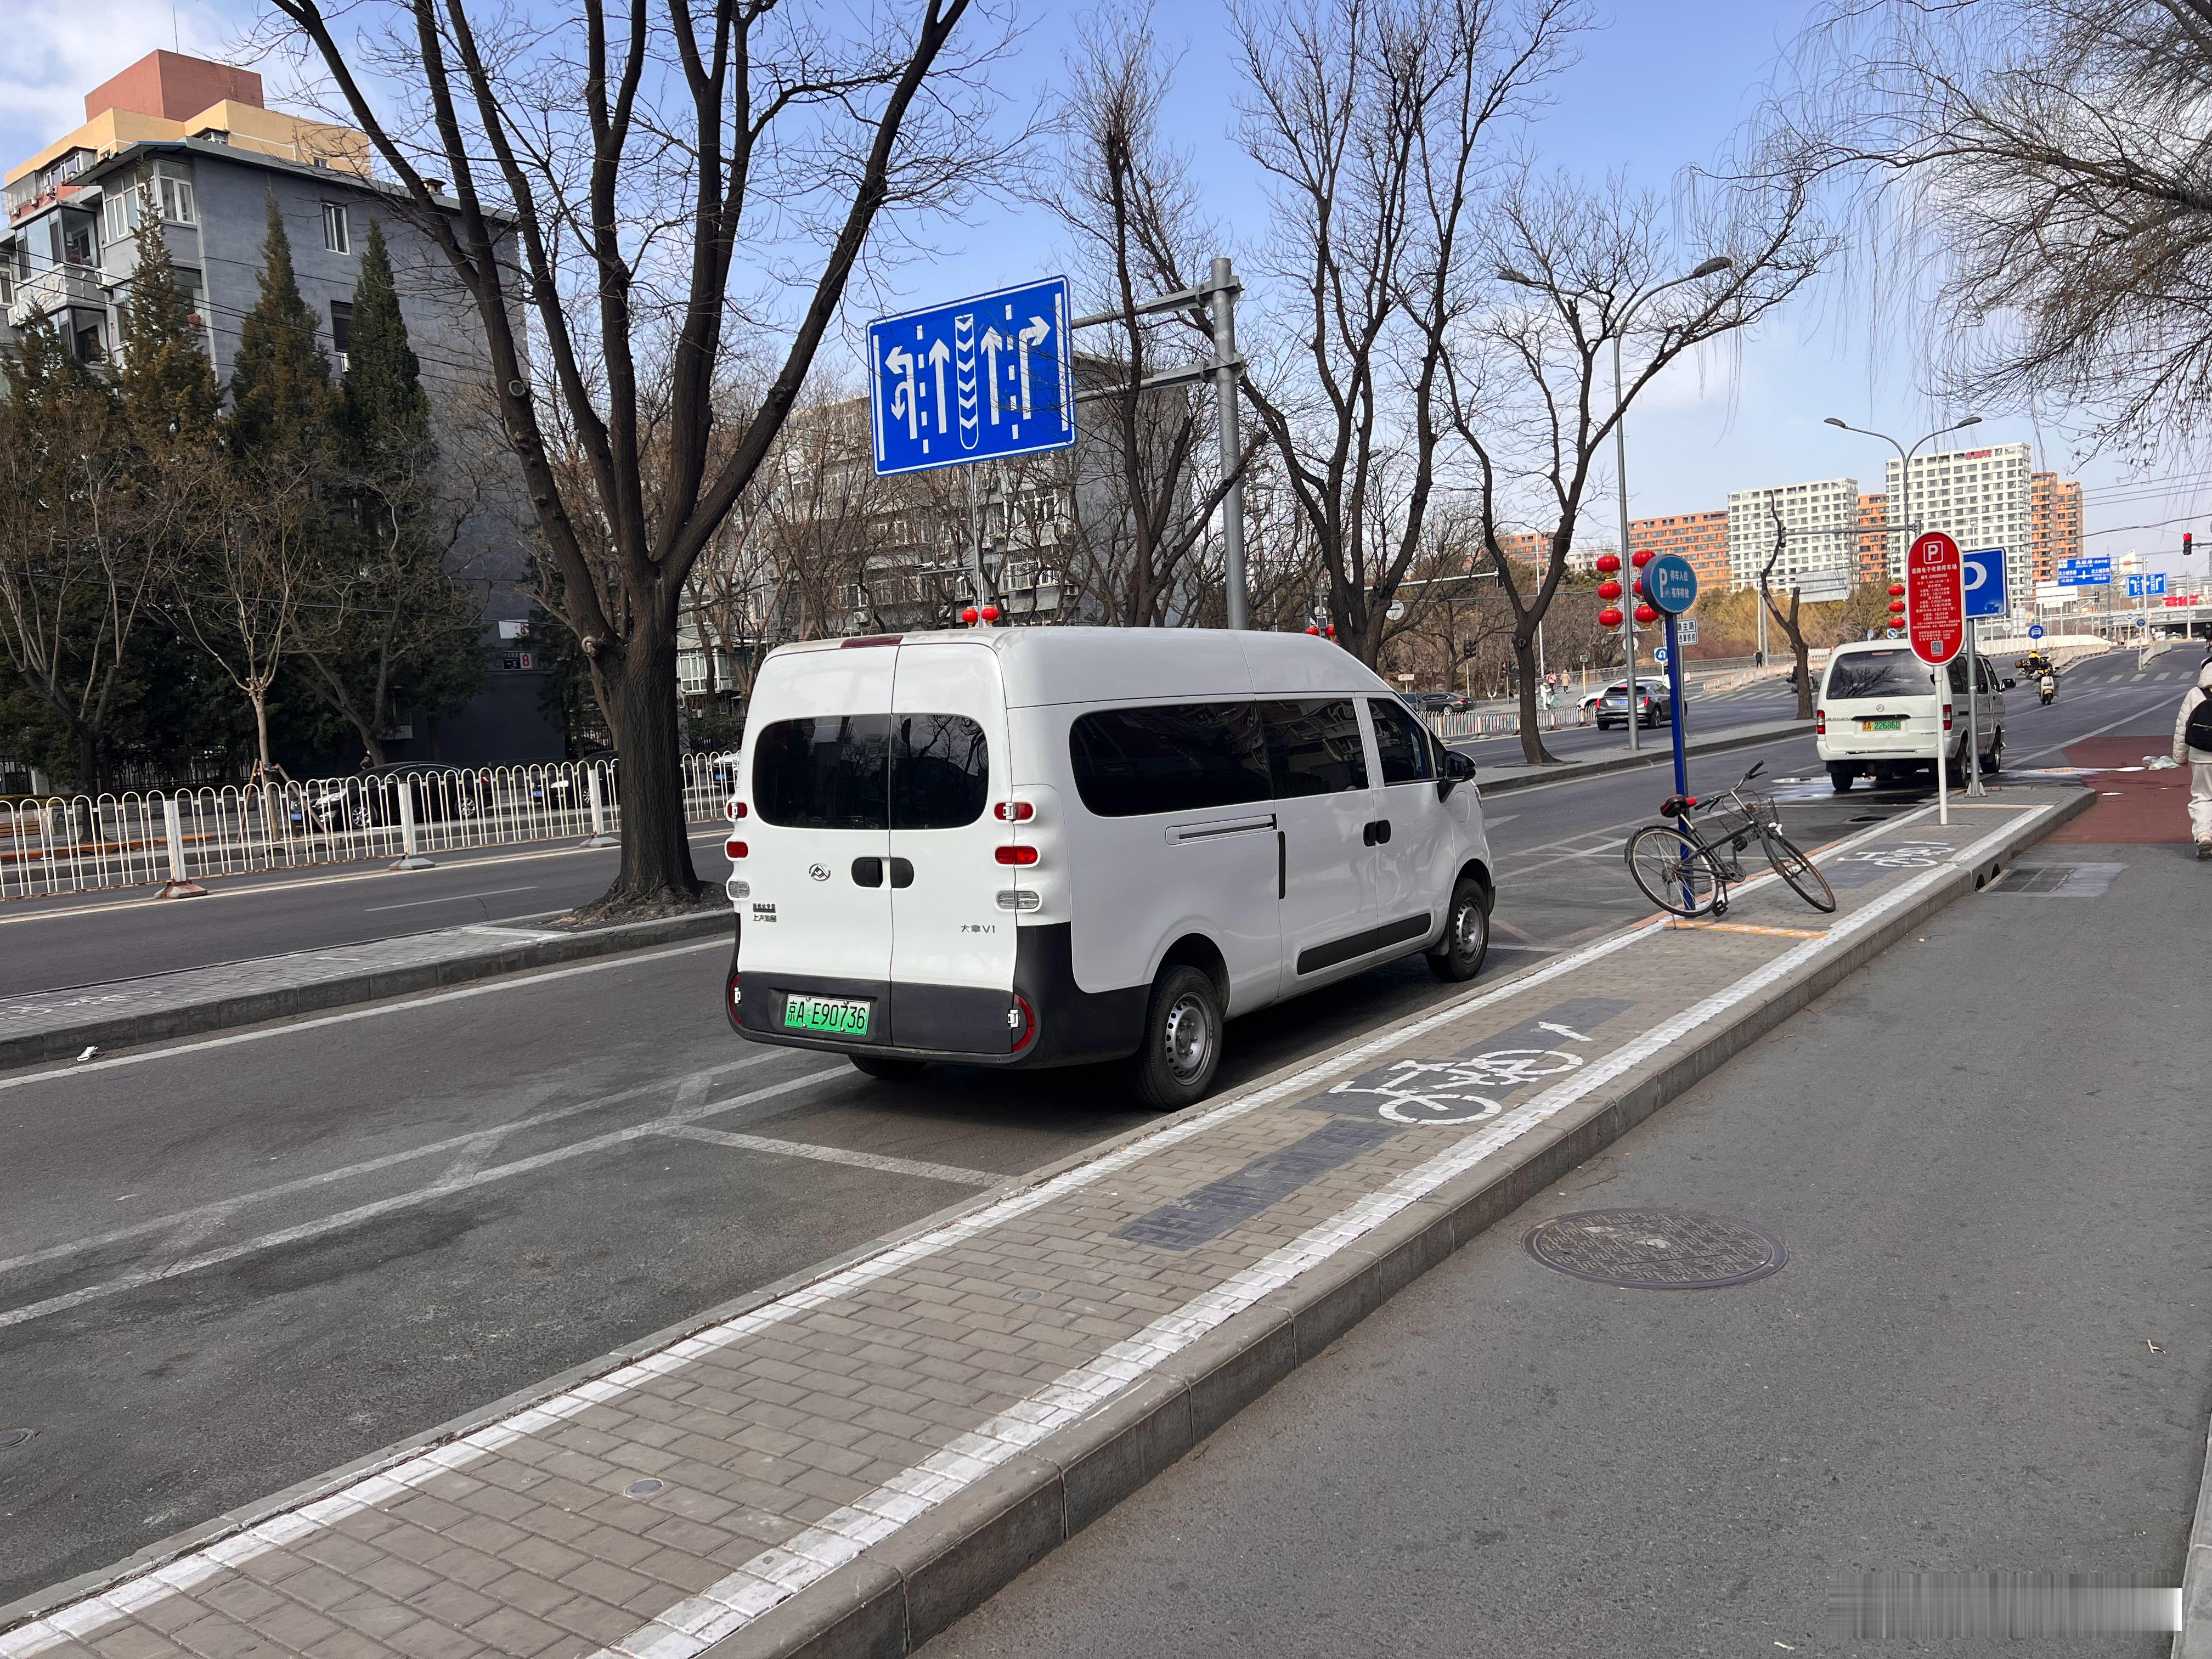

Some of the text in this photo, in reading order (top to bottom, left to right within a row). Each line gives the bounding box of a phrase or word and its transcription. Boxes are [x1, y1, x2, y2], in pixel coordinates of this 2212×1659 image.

[1928, 544, 1938, 561] P
[1670, 569, 1689, 582] 停车入位
[1658, 568, 1668, 599] P
[1671, 587, 1690, 599] 有序停放
